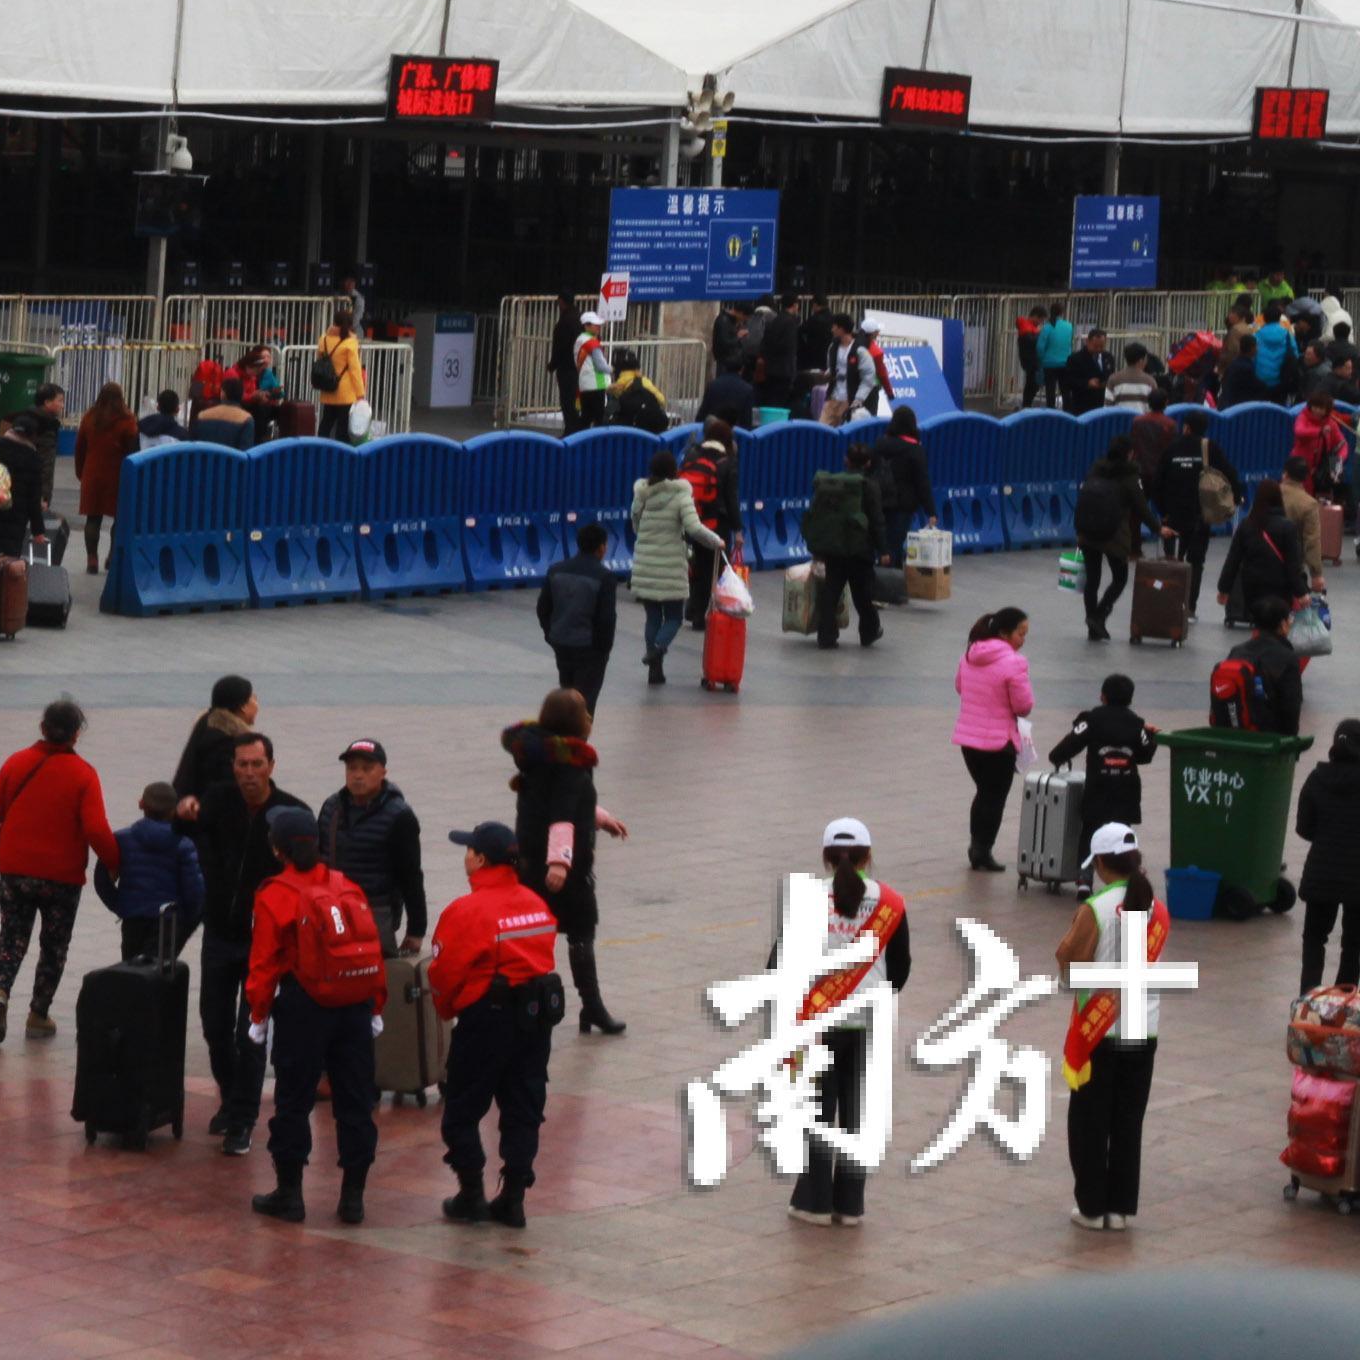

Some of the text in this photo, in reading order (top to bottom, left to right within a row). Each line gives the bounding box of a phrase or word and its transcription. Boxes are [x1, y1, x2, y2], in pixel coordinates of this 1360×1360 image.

[889, 84, 966, 115] 广州站欢迎您
[667, 194, 726, 216] 温馨提示
[445, 358, 461, 380] 33
[1182, 766, 1245, 789] 作业中心
